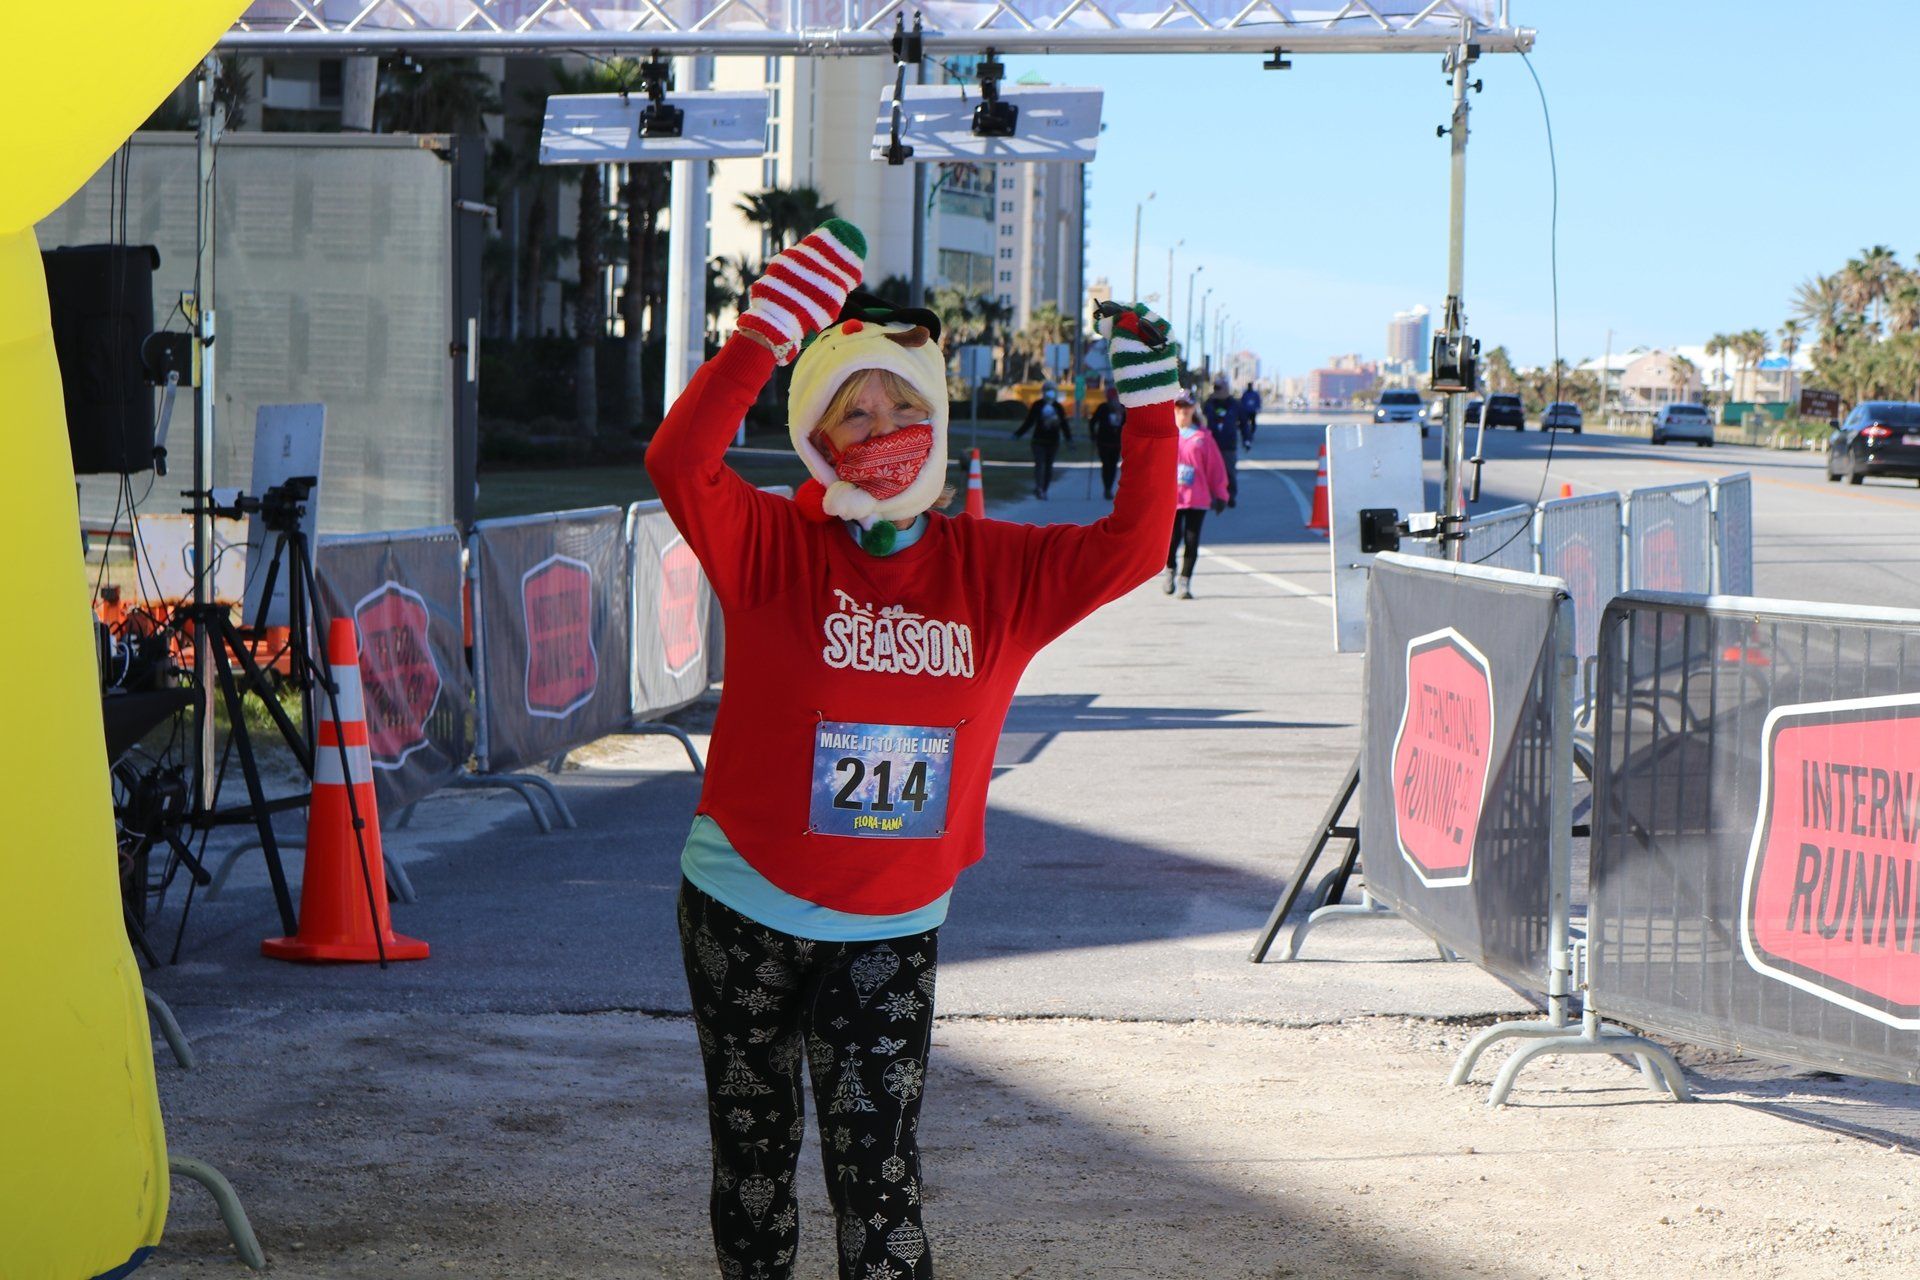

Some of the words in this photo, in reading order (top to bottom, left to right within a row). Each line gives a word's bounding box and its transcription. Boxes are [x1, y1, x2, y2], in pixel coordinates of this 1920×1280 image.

[823, 612, 975, 678] SEASON
[820, 732, 858, 750] MAKE
[862, 735, 874, 751] IT
[878, 737, 893, 752] TO
[897, 738, 919, 753] THE
[921, 738, 950, 754] LINE
[833, 757, 928, 812] 214
[1400, 747, 1462, 836] RUNNING
[853, 815, 903, 831] FLORA-BAMA
